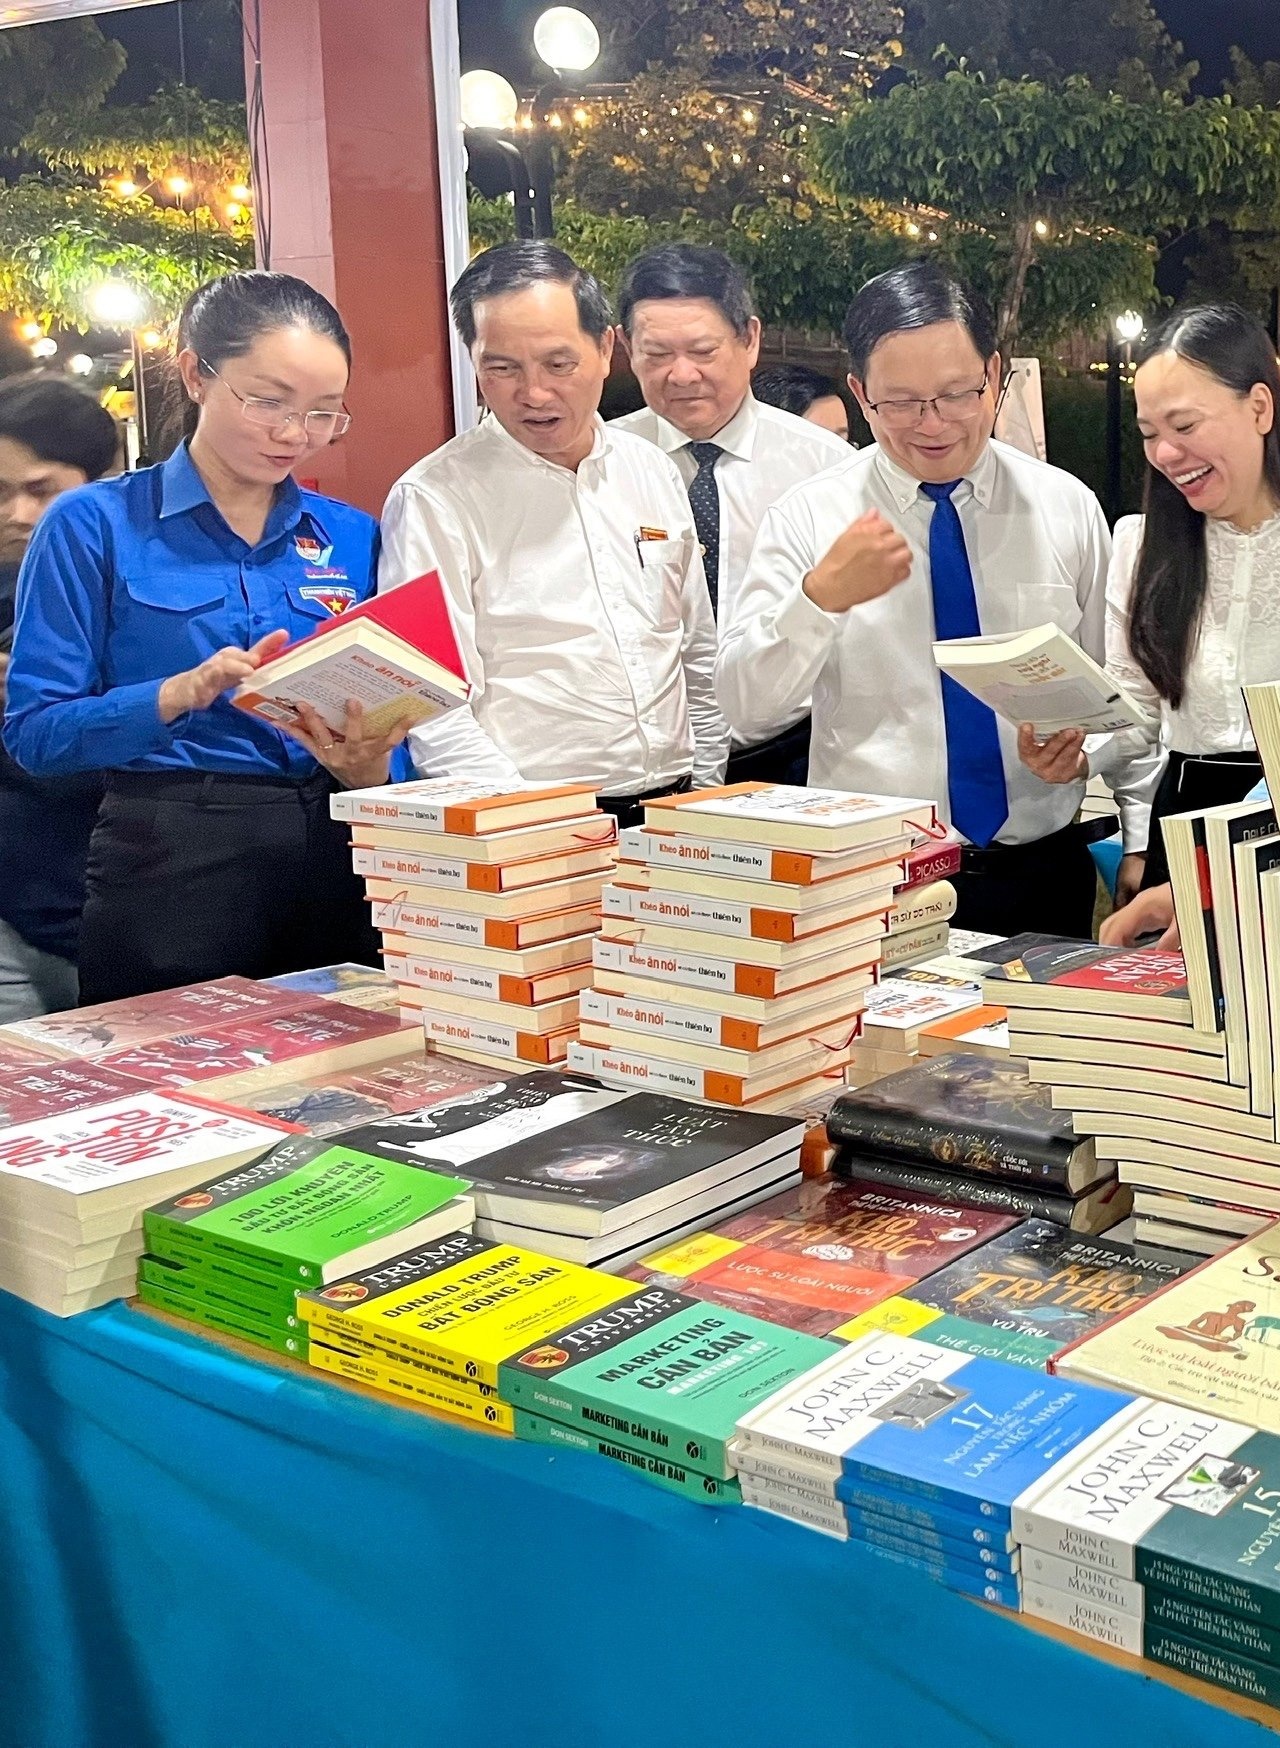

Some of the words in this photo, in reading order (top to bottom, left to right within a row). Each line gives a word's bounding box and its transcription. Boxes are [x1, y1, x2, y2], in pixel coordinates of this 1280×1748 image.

[659, 843, 676, 854] Khéo
[678, 845, 691, 858] ăn
[693, 846, 709, 860] nói
[916, 856, 951, 877] PICASSO
[206, 1145, 296, 1194] TRUMP
[294, 1160, 356, 1197] KHUYÊN
[860, 1193, 963, 1219] BRITANNICA
[360, 1236, 469, 1285] TRUMP
[1048, 1265, 1142, 1292] KHO
[1070, 1243, 1182, 1276] BRITANNICA
[382, 1278, 461, 1318] DONALD
[461, 1255, 521, 1289] TRUMP
[417, 1309, 461, 1330] BẤT
[464, 1285, 520, 1314] ĐỘNG
[518, 1266, 563, 1287] SẢN
[557, 1291, 666, 1346] TRUMP
[578, 1298, 683, 1352] UNIVERSITY
[596, 1318, 726, 1382] MARKETING
[636, 1359, 695, 1390] CĂN
[696, 1330, 755, 1363] BẢN
[935, 1334, 966, 1350] THẾ
[666, 1354, 744, 1395] MARKETING
[786, 1367, 868, 1423] JOHN
[804, 1351, 945, 1440] MAXWELL
[534, 1391, 552, 1404] DON
[552, 1395, 573, 1411] SEXTON
[582, 1406, 631, 1433] MARKETING
[631, 1420, 650, 1439] CĂN
[651, 1425, 669, 1448] BẢN
[951, 1402, 994, 1430] 17
[1064, 1439, 1146, 1502] JOHN
[1087, 1421, 1219, 1524] MAXWELL
[1069, 1616, 1126, 1646] MAXWELL
[1075, 1604, 1106, 1625] JOHN
[1164, 1649, 1187, 1666] PHÁT
[1170, 1642, 1210, 1663] NGUYÊN
